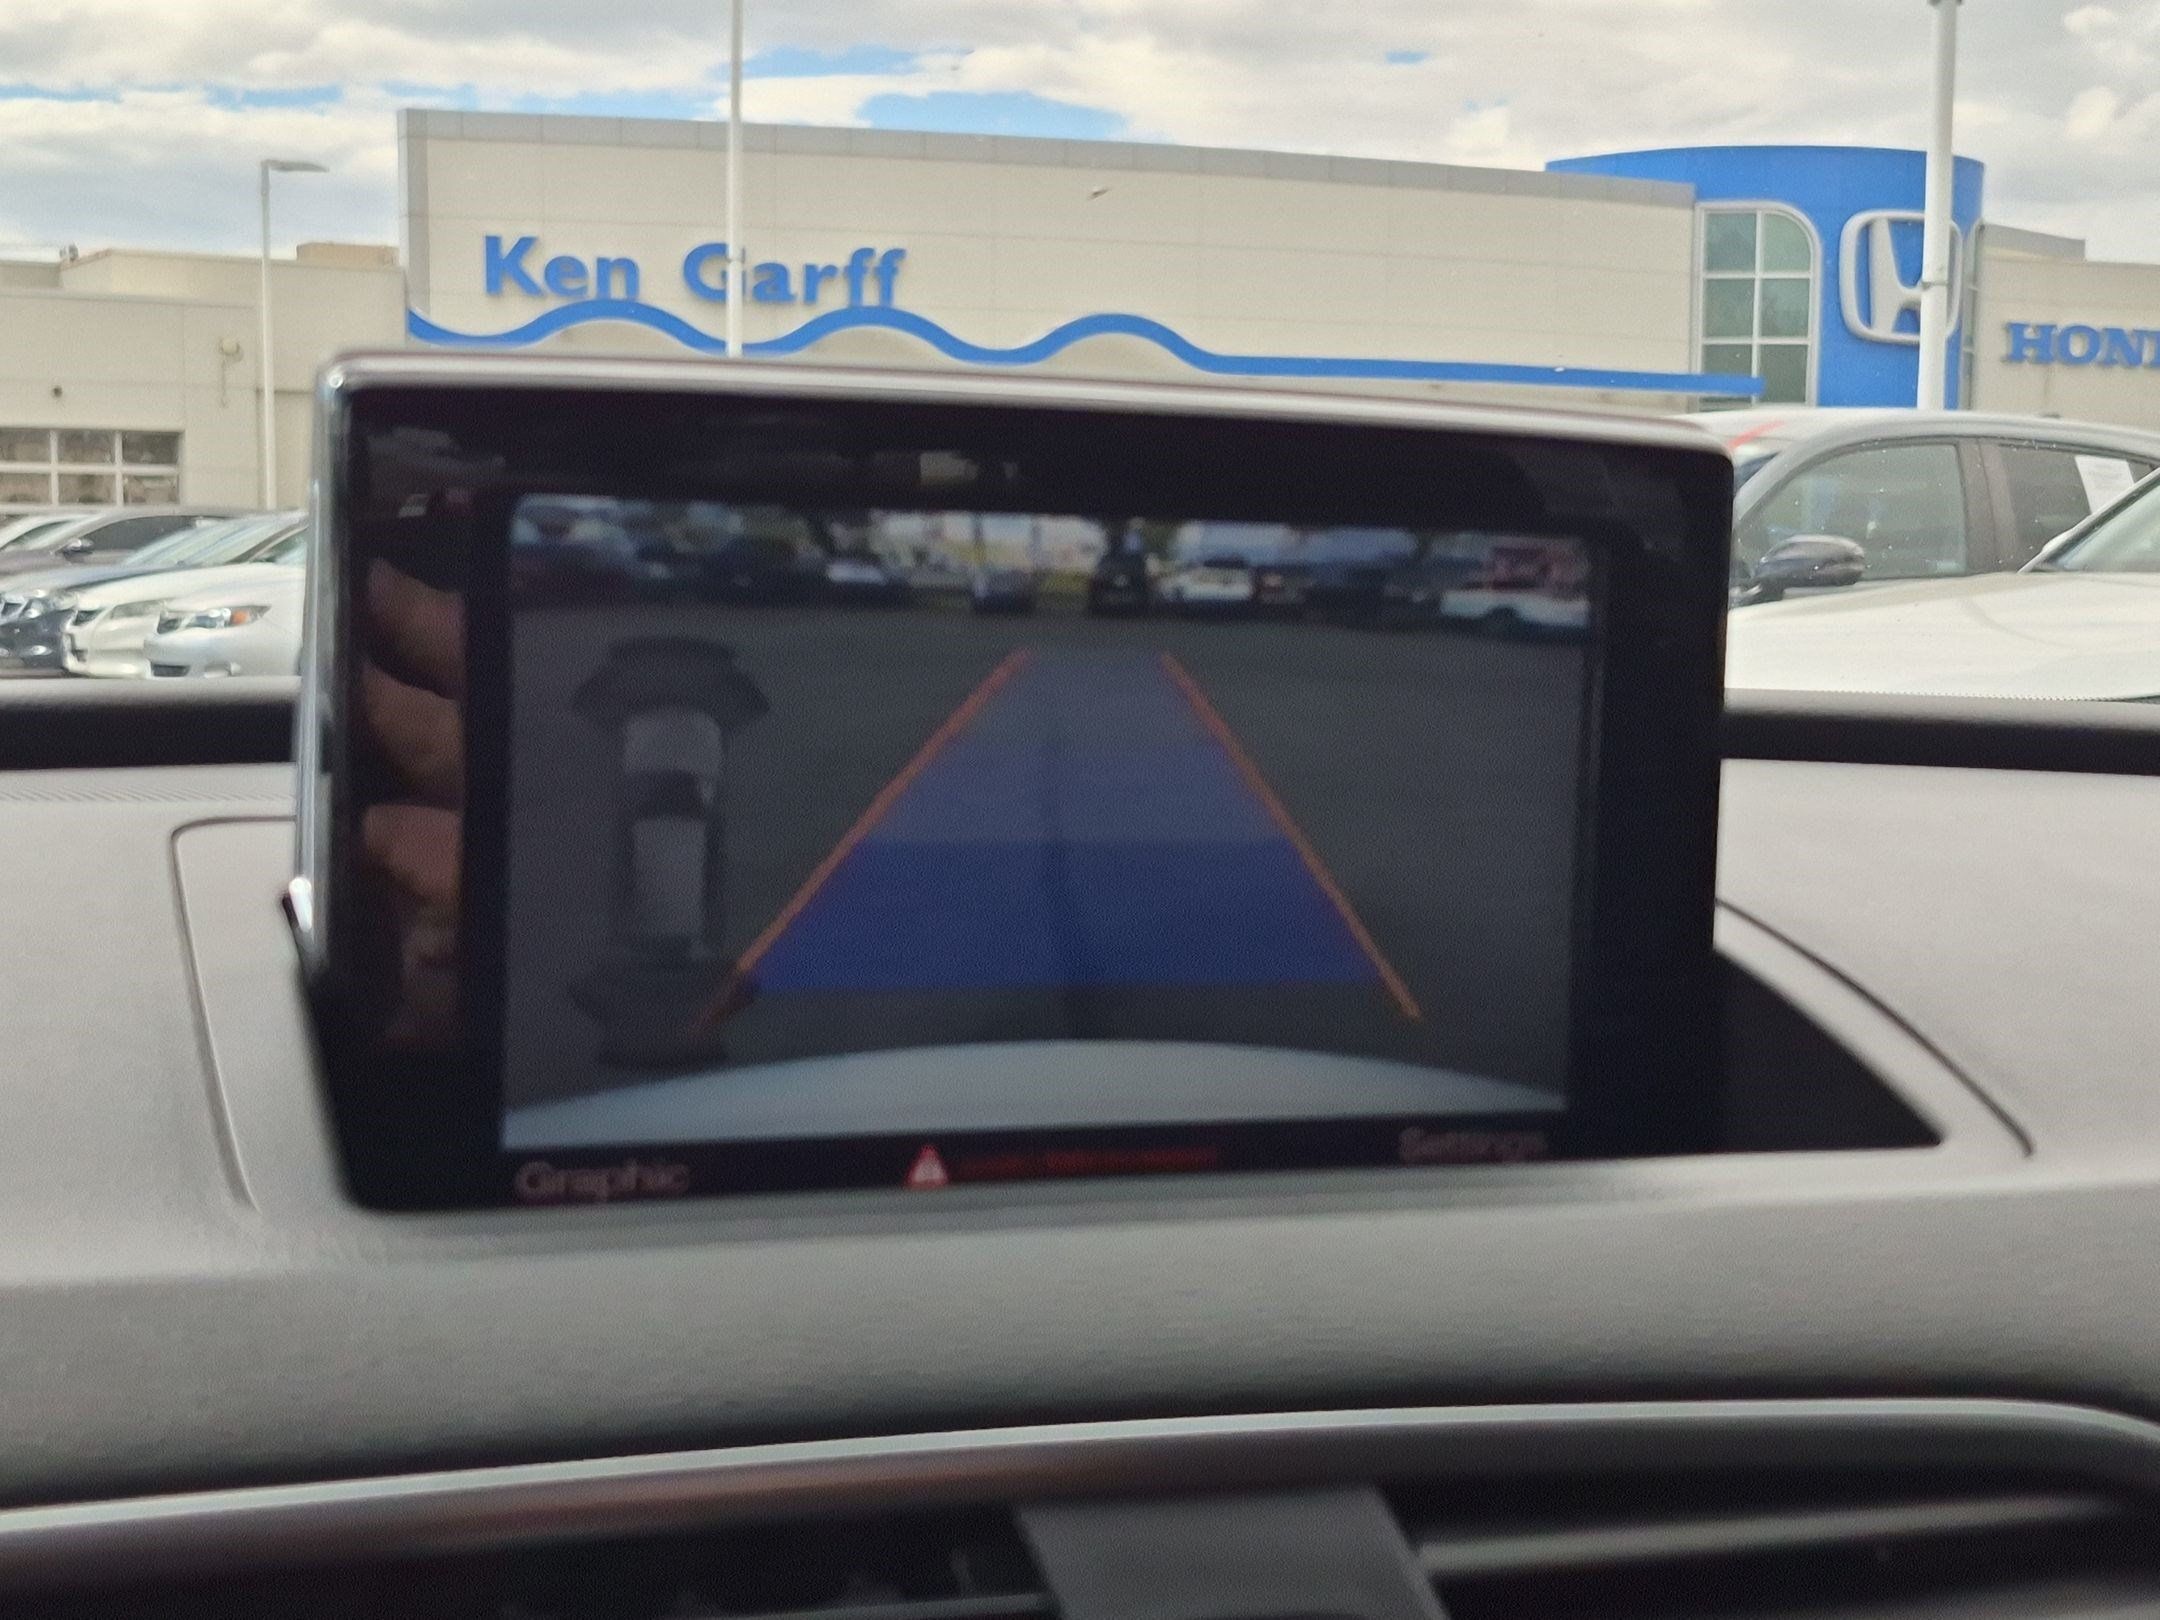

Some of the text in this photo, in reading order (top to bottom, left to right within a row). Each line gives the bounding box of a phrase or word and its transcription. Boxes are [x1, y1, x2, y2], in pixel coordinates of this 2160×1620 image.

[484, 235, 907, 308] Ken Garff
[2005, 322, 2160, 367] HON
[514, 1160, 690, 1203] Graphic
